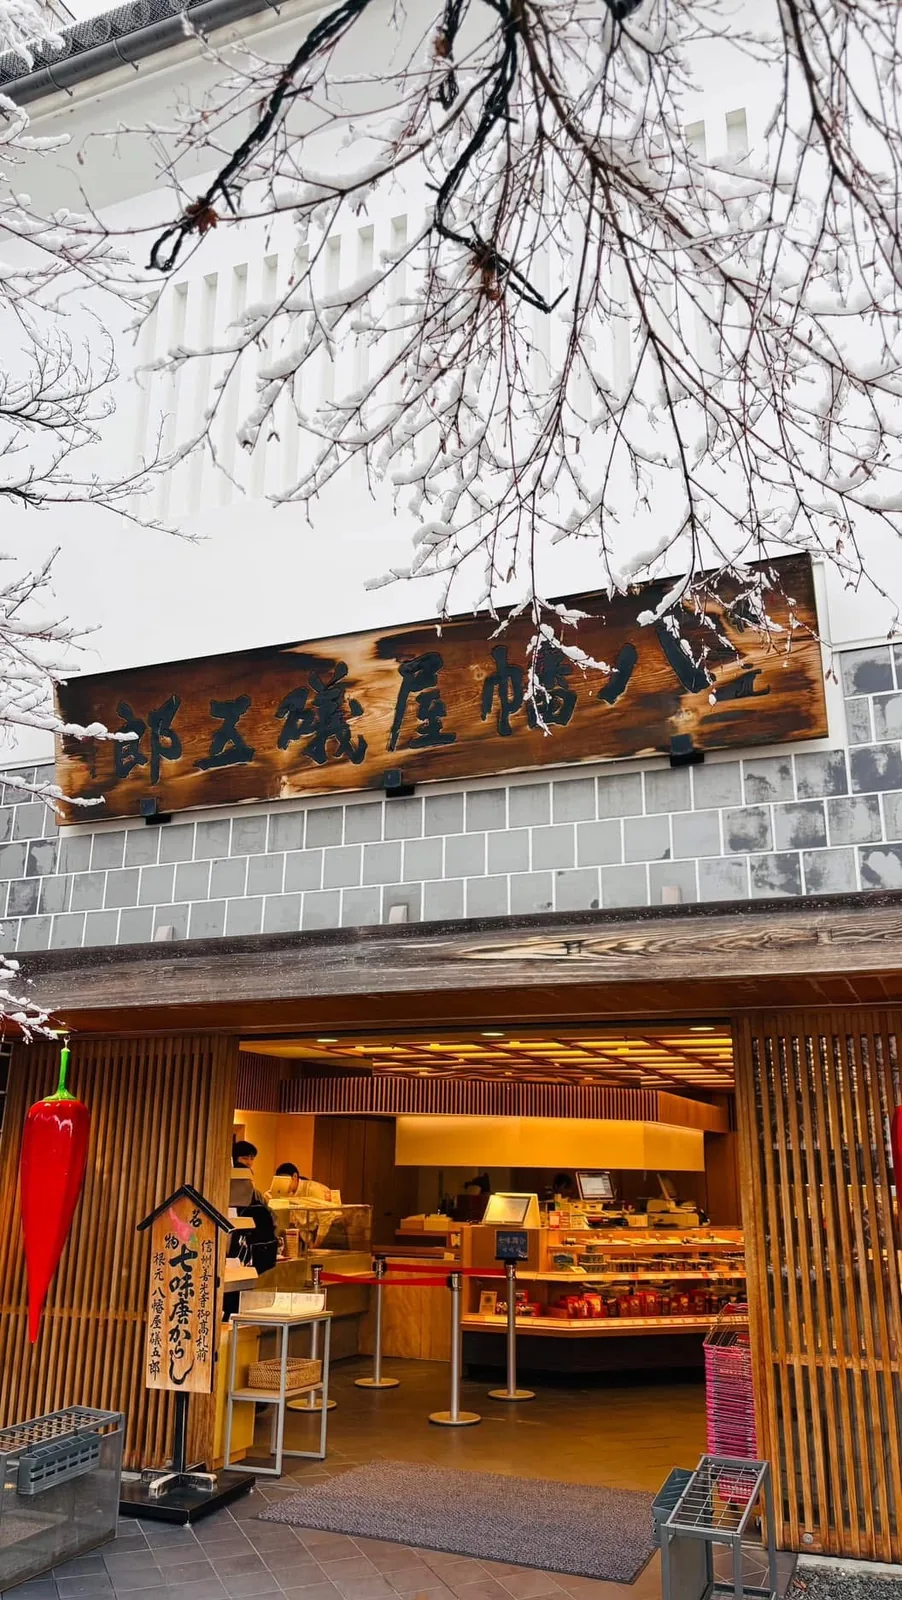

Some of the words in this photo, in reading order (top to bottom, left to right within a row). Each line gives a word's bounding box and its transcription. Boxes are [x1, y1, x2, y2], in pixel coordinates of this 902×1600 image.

[168, 1243, 199, 1386] 七味唐からし
